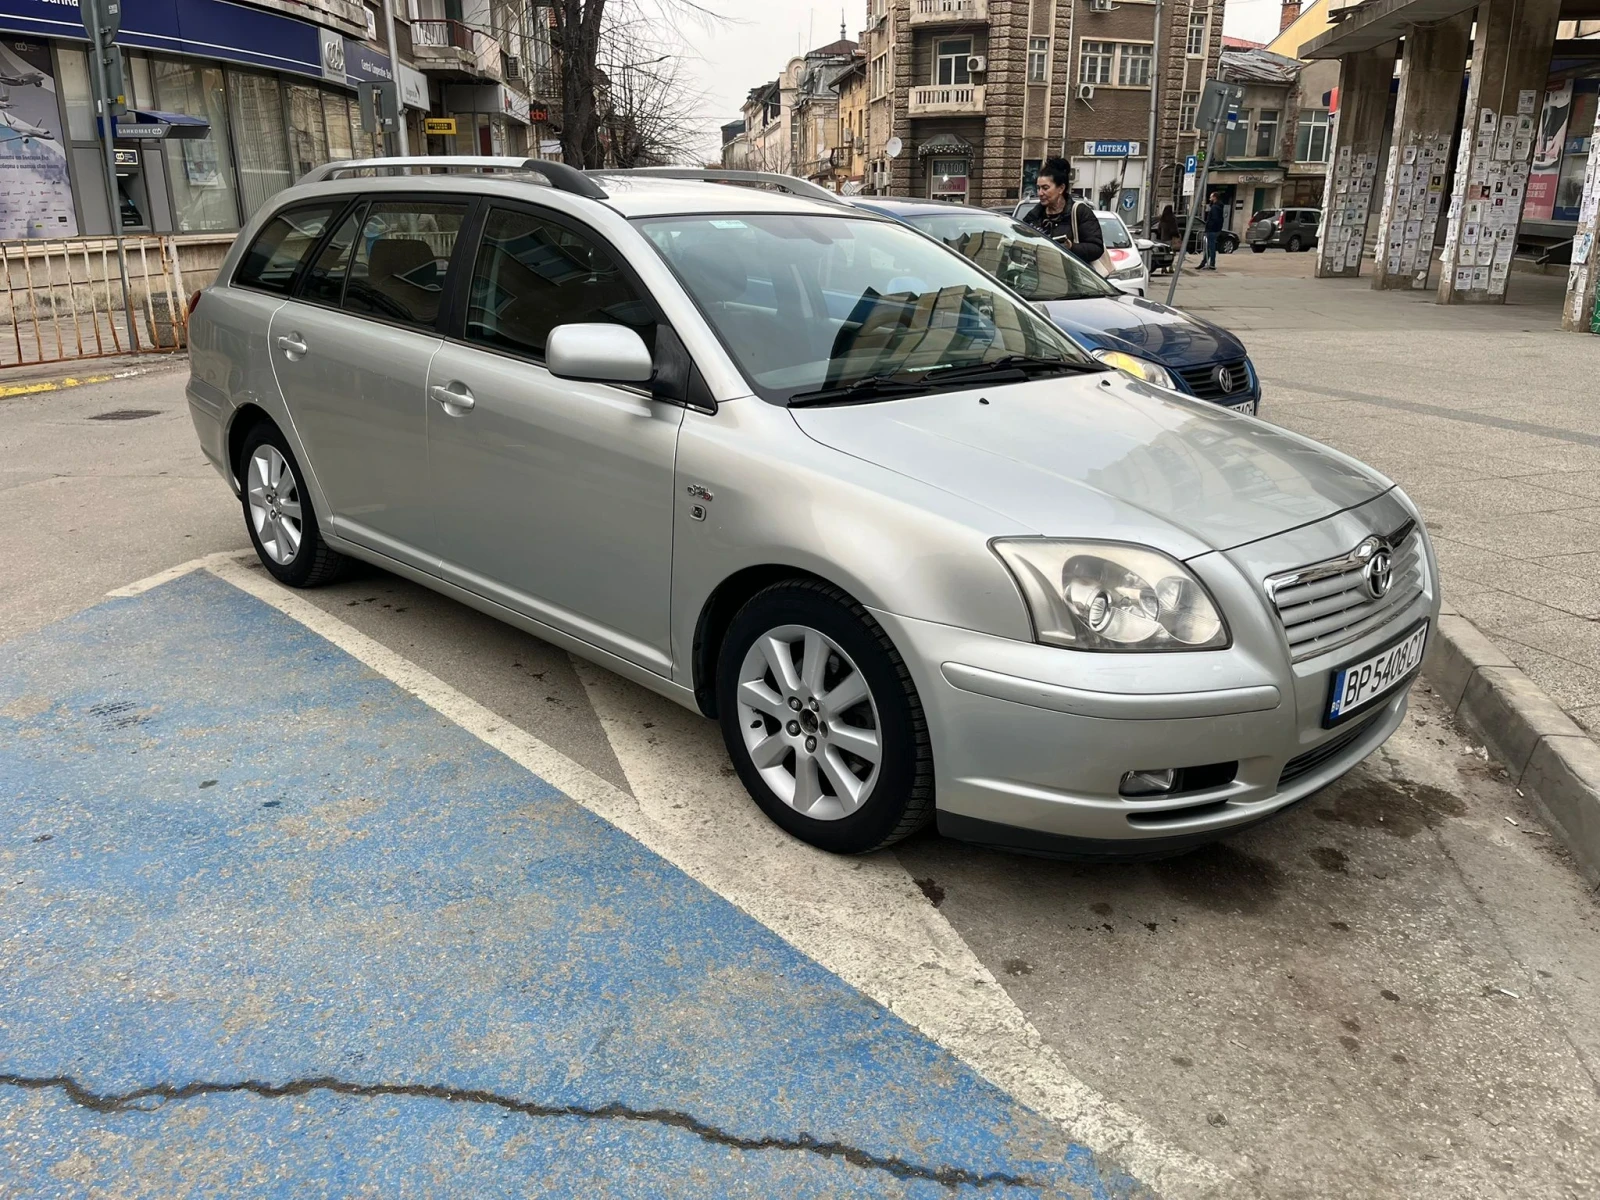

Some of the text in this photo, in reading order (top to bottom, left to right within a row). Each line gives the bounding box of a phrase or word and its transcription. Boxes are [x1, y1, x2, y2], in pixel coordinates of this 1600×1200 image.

[530, 108, 547, 120] tbi
[1096, 144, 1127, 153] АПТЕКА
[938, 163, 964, 173] TATTOO
[1187, 158, 1195, 171] P
